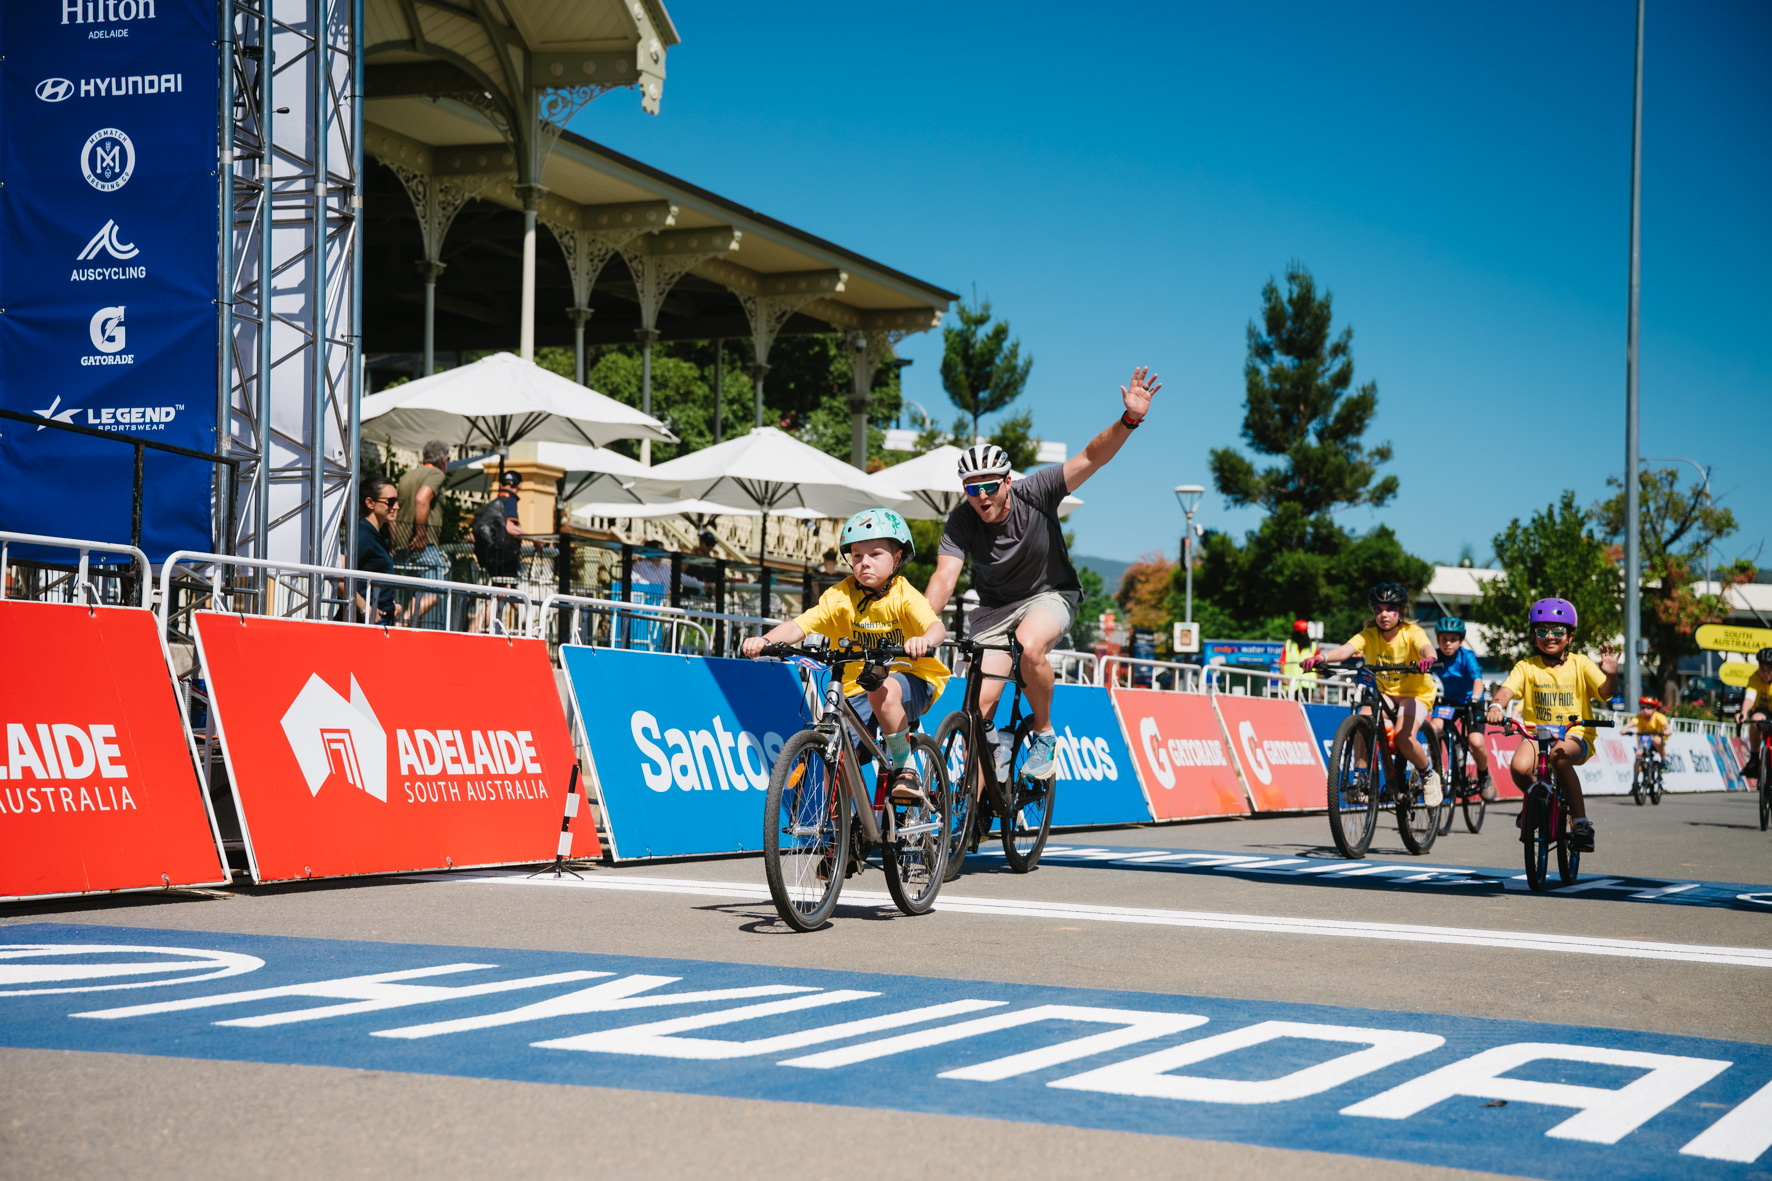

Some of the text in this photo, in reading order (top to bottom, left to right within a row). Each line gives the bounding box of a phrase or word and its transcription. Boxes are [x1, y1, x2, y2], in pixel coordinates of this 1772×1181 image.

[60, 0, 156, 25] Hilton
[88, 28, 129, 39] ADELAIDE
[80, 73, 182, 97] HYUNDAI
[89, 130, 128, 144] MISMATCH
[86, 174, 120, 190] BREWING
[70, 266, 147, 282] AUSCYCLING
[80, 354, 135, 367] GATORADE
[1241, 646, 1265, 654] water
[1534, 691, 1575, 707] FAMILY RIDE
[1535, 706, 1552, 722] 2026
[0, 723, 129, 780] AIDE
[396, 729, 542, 776] ADELAIDE
[1167, 738, 1228, 767] GATORADE
[1262, 740, 1317, 766] GATORADE
[404, 779, 549, 803] SOUTH AUSTRALIA
[68, 963, 1772, 1164] HYUNDAI
